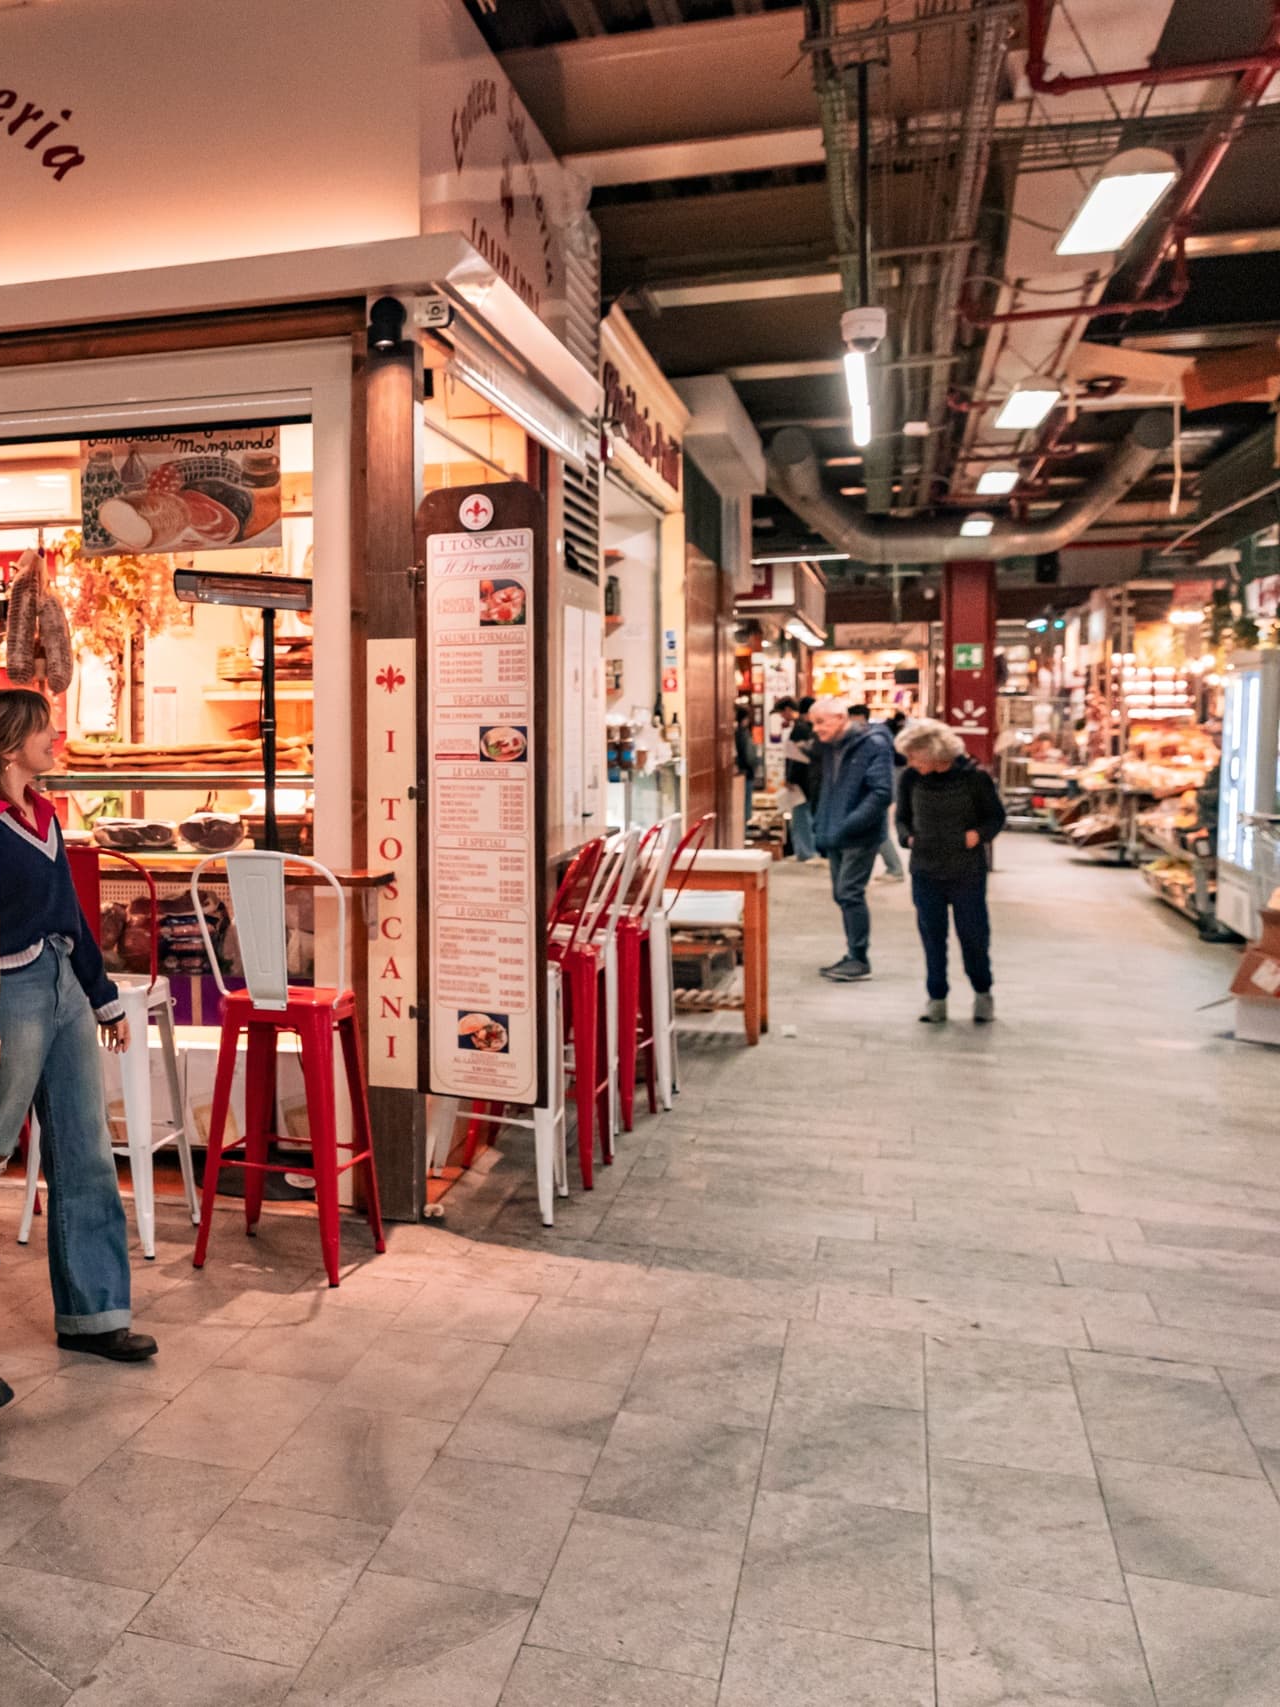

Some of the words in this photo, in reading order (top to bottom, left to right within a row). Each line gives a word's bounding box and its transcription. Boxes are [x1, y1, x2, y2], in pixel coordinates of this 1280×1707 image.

[449, 534, 525, 552] TOSCANI
[384, 730, 396, 753] I
[452, 767, 461, 777] LE
[378, 797, 403, 1059] TOSCANI
